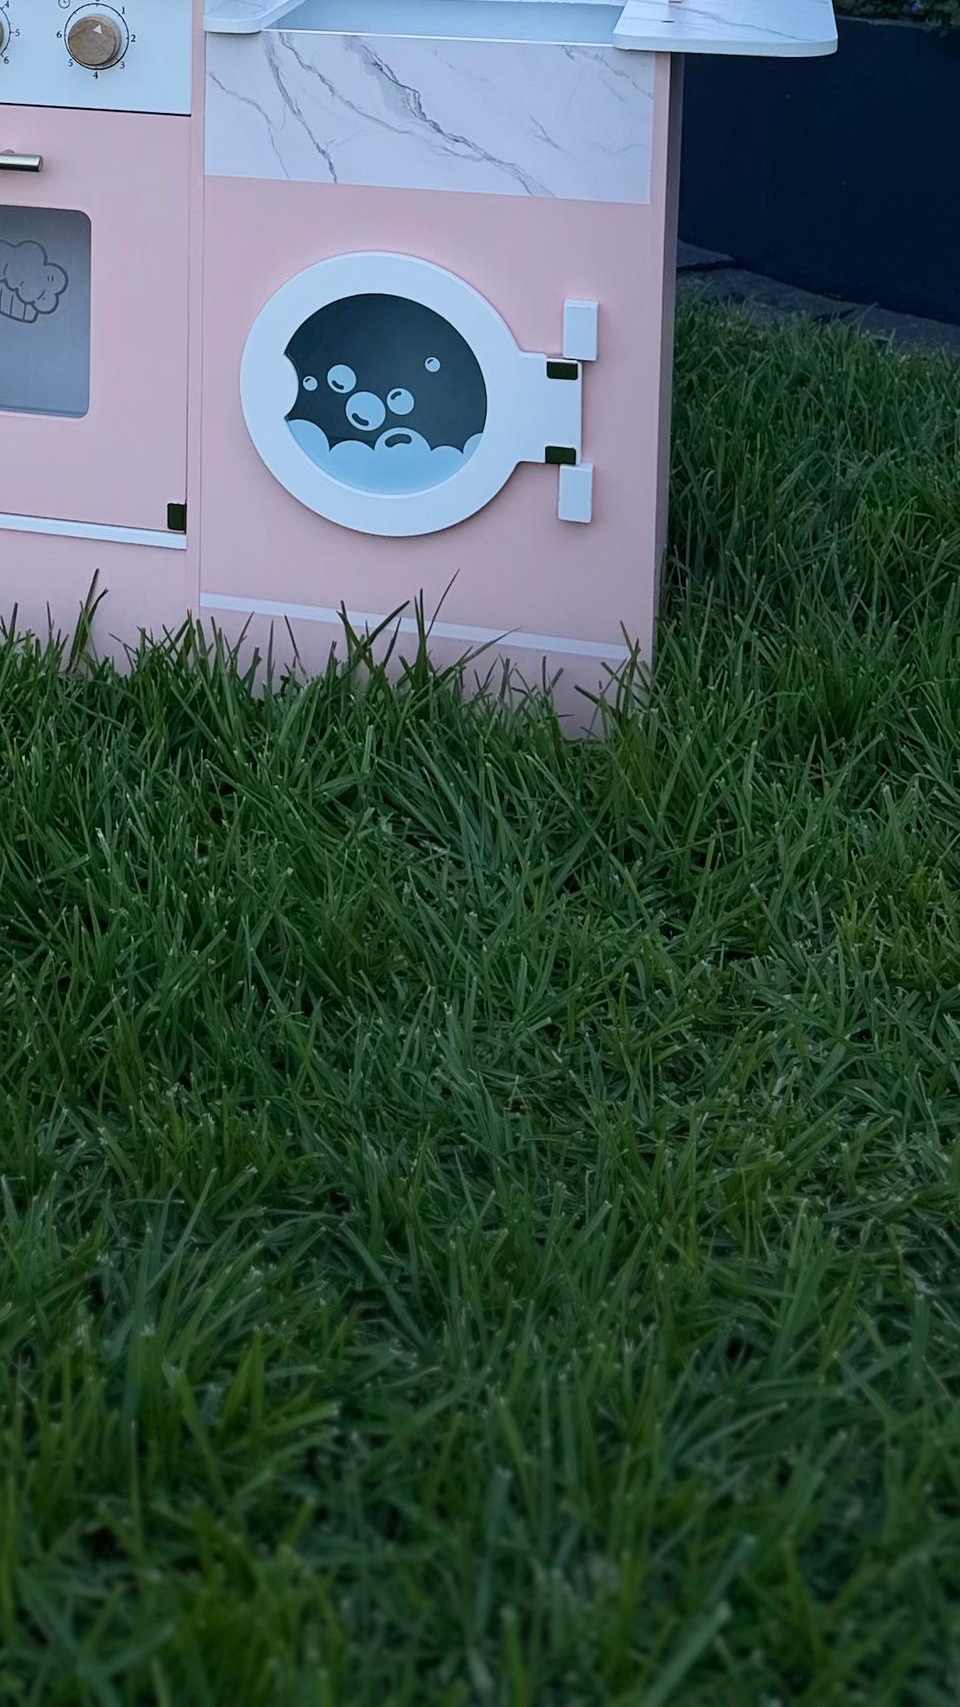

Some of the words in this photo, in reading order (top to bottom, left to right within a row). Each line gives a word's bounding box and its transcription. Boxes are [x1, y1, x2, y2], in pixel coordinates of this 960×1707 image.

[4, 0, 9, 8] 4
[15, 29, 20, 37] 5
[3, 56, 9, 64] 6
[120, 61, 125, 69] 3
